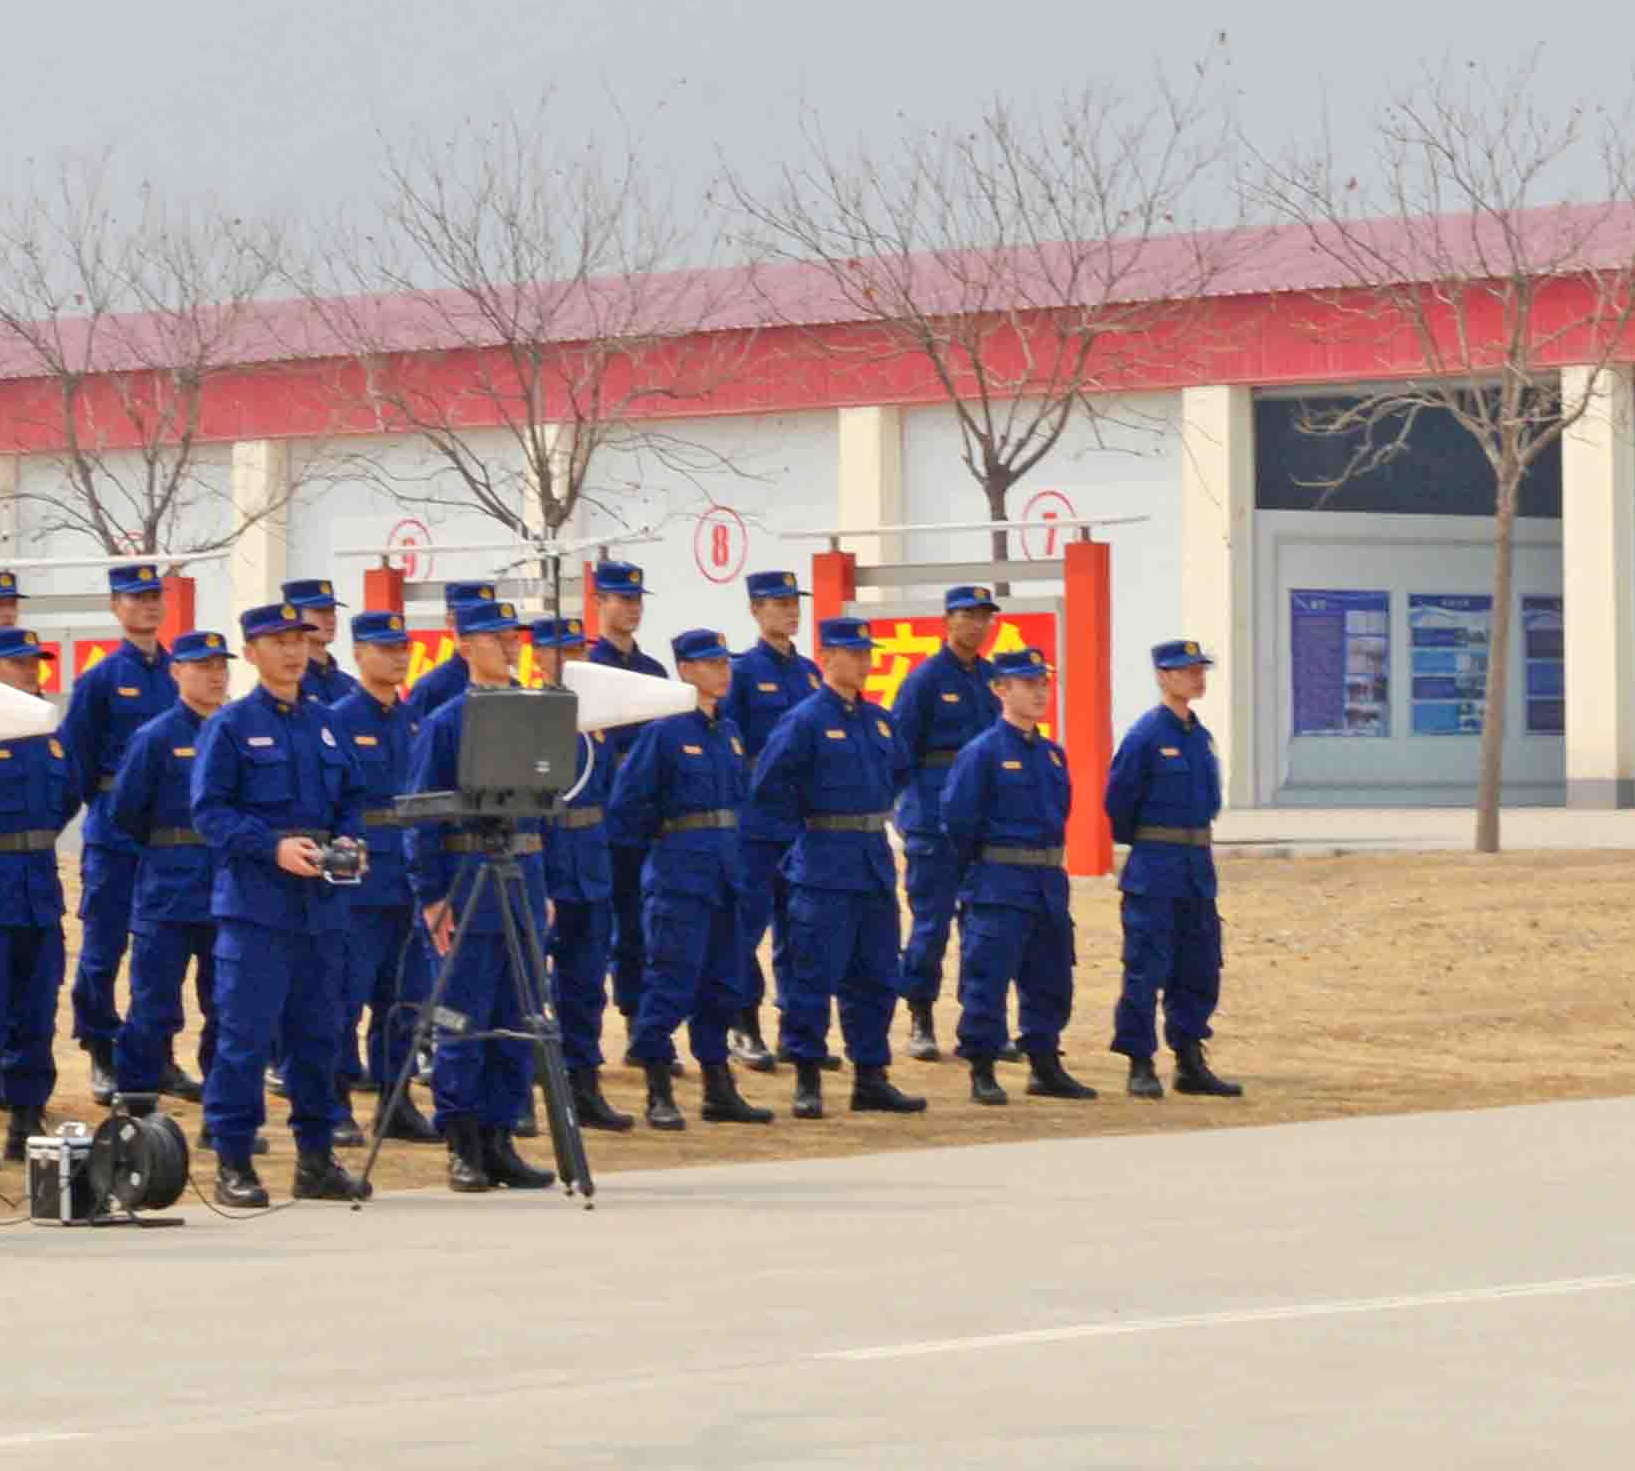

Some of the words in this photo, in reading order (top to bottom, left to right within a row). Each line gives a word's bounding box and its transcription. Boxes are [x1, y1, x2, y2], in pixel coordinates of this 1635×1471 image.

[399, 535, 417, 577] 9
[711, 523, 730, 567] 8
[1040, 512, 1058, 556] 7
